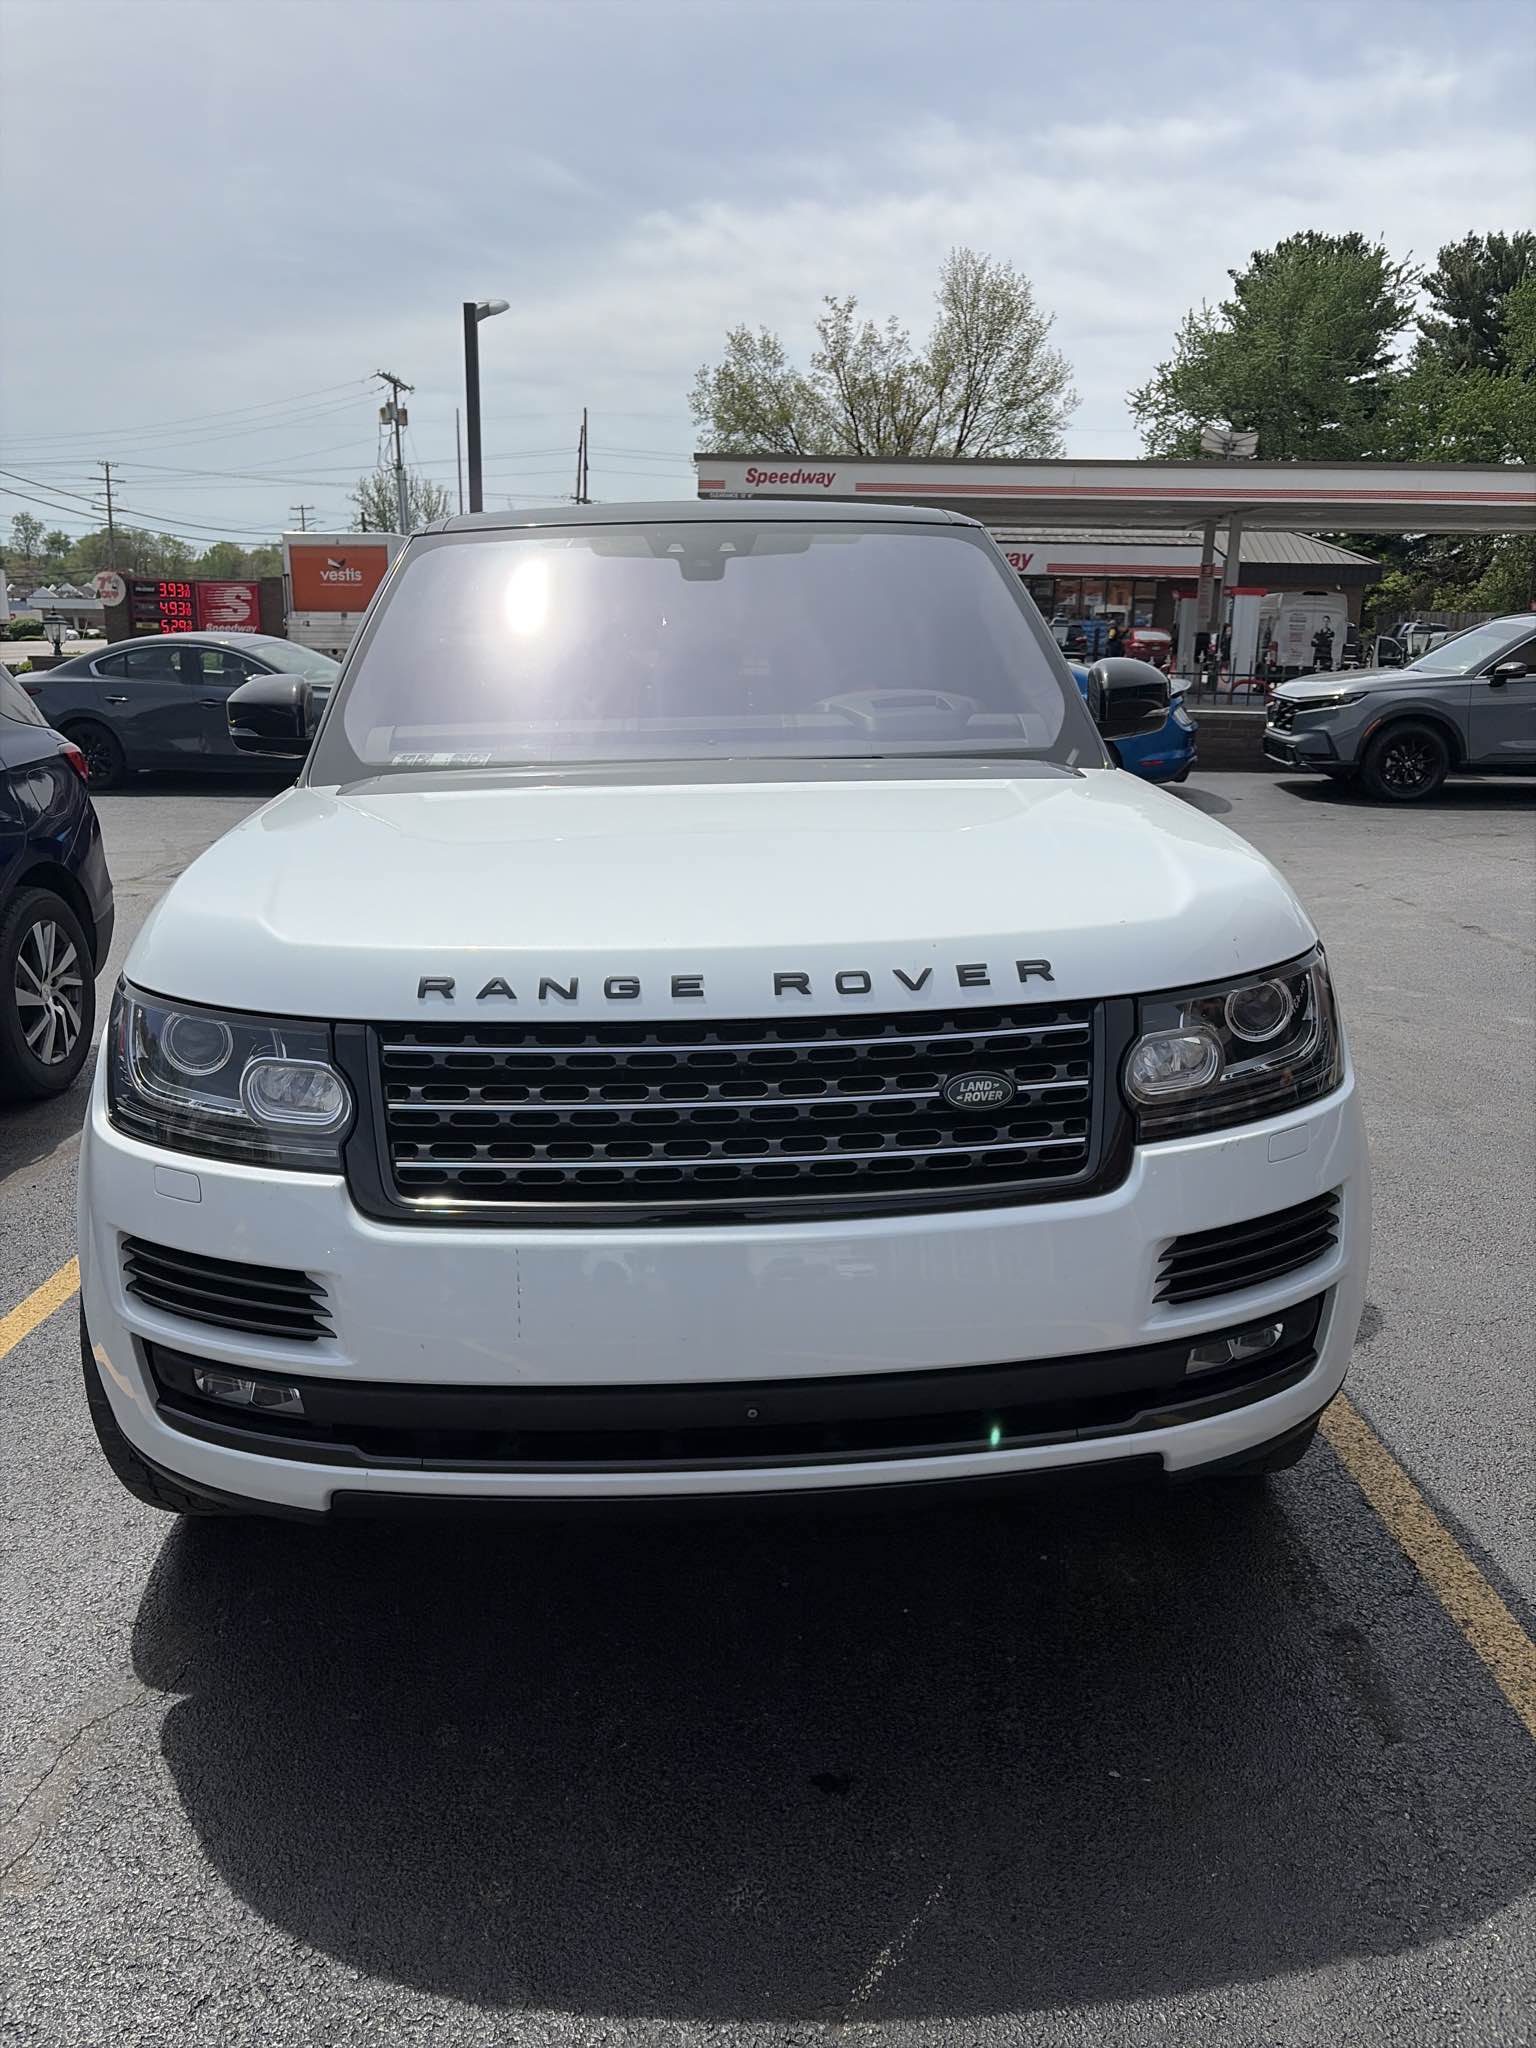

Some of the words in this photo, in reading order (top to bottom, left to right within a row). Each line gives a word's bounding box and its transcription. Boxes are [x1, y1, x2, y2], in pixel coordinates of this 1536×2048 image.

[745, 467, 836, 488] Speedway
[320, 567, 362, 581] vestis
[417, 973, 705, 1000] RANGE
[773, 958, 1056, 996] ROVER
[960, 1081, 992, 1092] LAND
[963, 1090, 1003, 1102] ROVER
